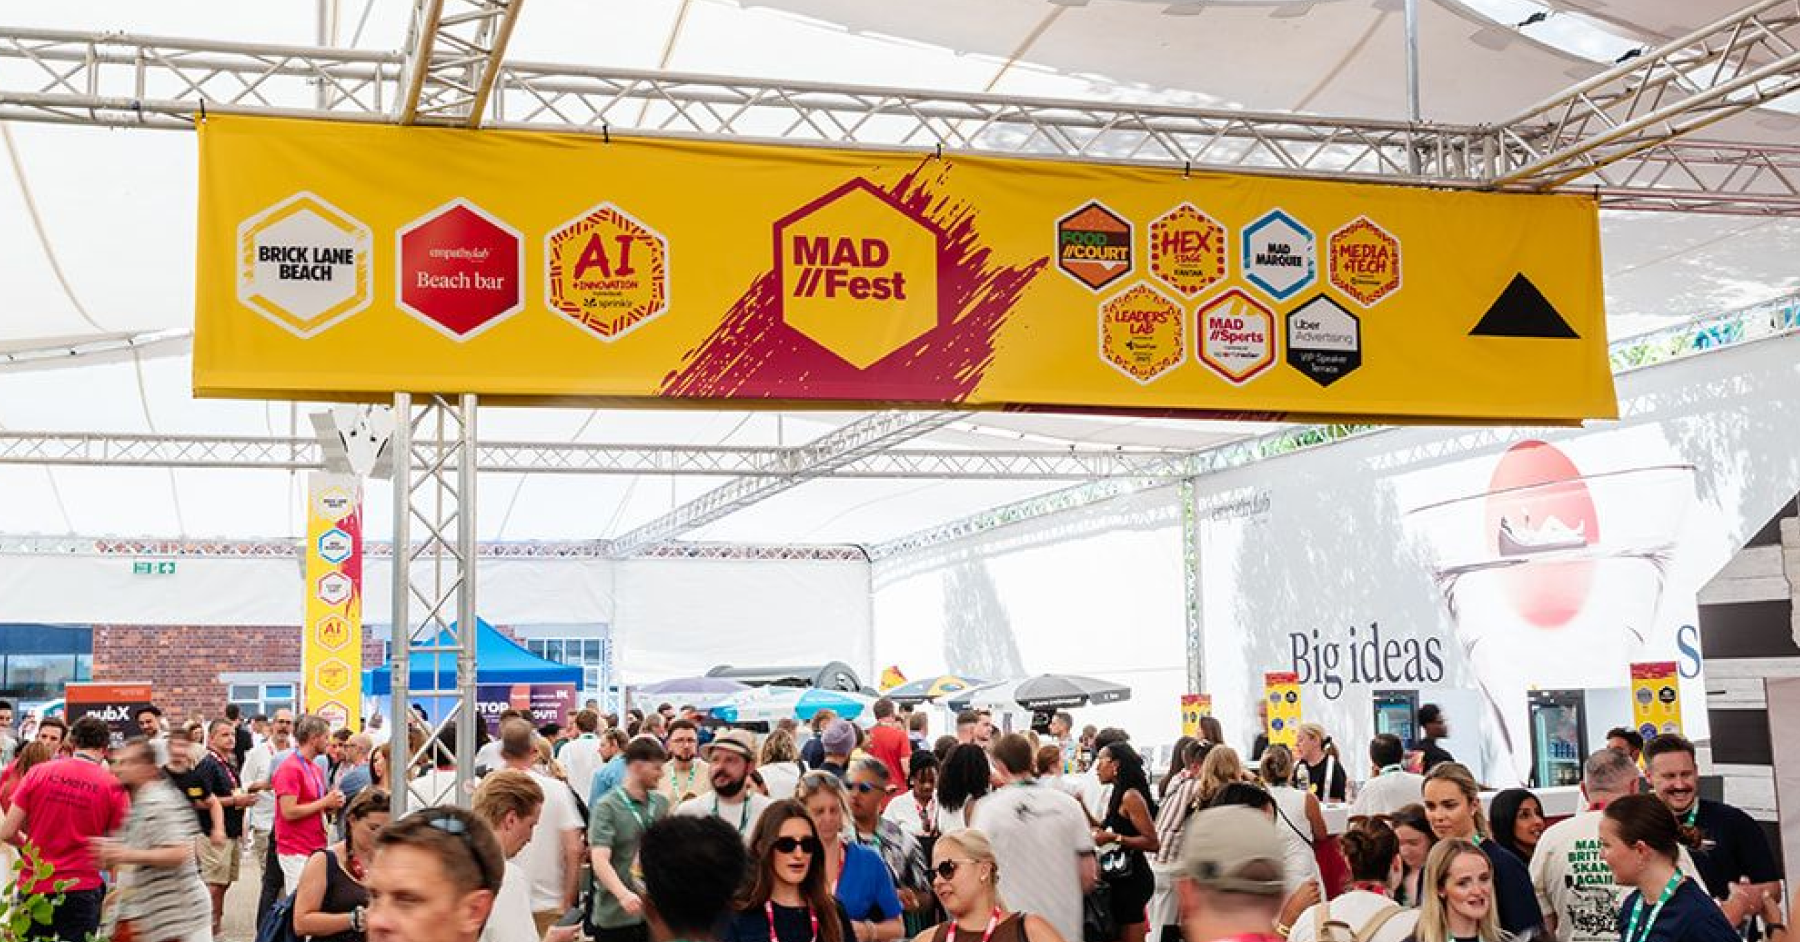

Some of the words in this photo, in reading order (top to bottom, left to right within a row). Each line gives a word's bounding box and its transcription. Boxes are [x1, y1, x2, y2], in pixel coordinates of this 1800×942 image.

[1061, 231, 1107, 245] FOOD
[1161, 230, 1211, 255] HEX
[258, 246, 308, 263] BRICK
[313, 247, 354, 264] LANE
[573, 233, 635, 279] AI
[793, 236, 889, 268] MAD
[1267, 243, 1291, 254] MAD
[1339, 244, 1389, 260] MEDIA
[1255, 253, 1302, 267] MARQUEE
[279, 264, 332, 281] BEACH
[417, 271, 471, 289] Beach
[474, 271, 505, 290] bar
[793, 268, 906, 300] //Fest
[1129, 323, 1155, 334] LAB
[1209, 317, 1244, 330] MAD
[1294, 319, 1321, 330] Uber
[1295, 331, 1353, 345] Advertising
[1289, 628, 1343, 699] Big
[1349, 622, 1444, 683] ideas
